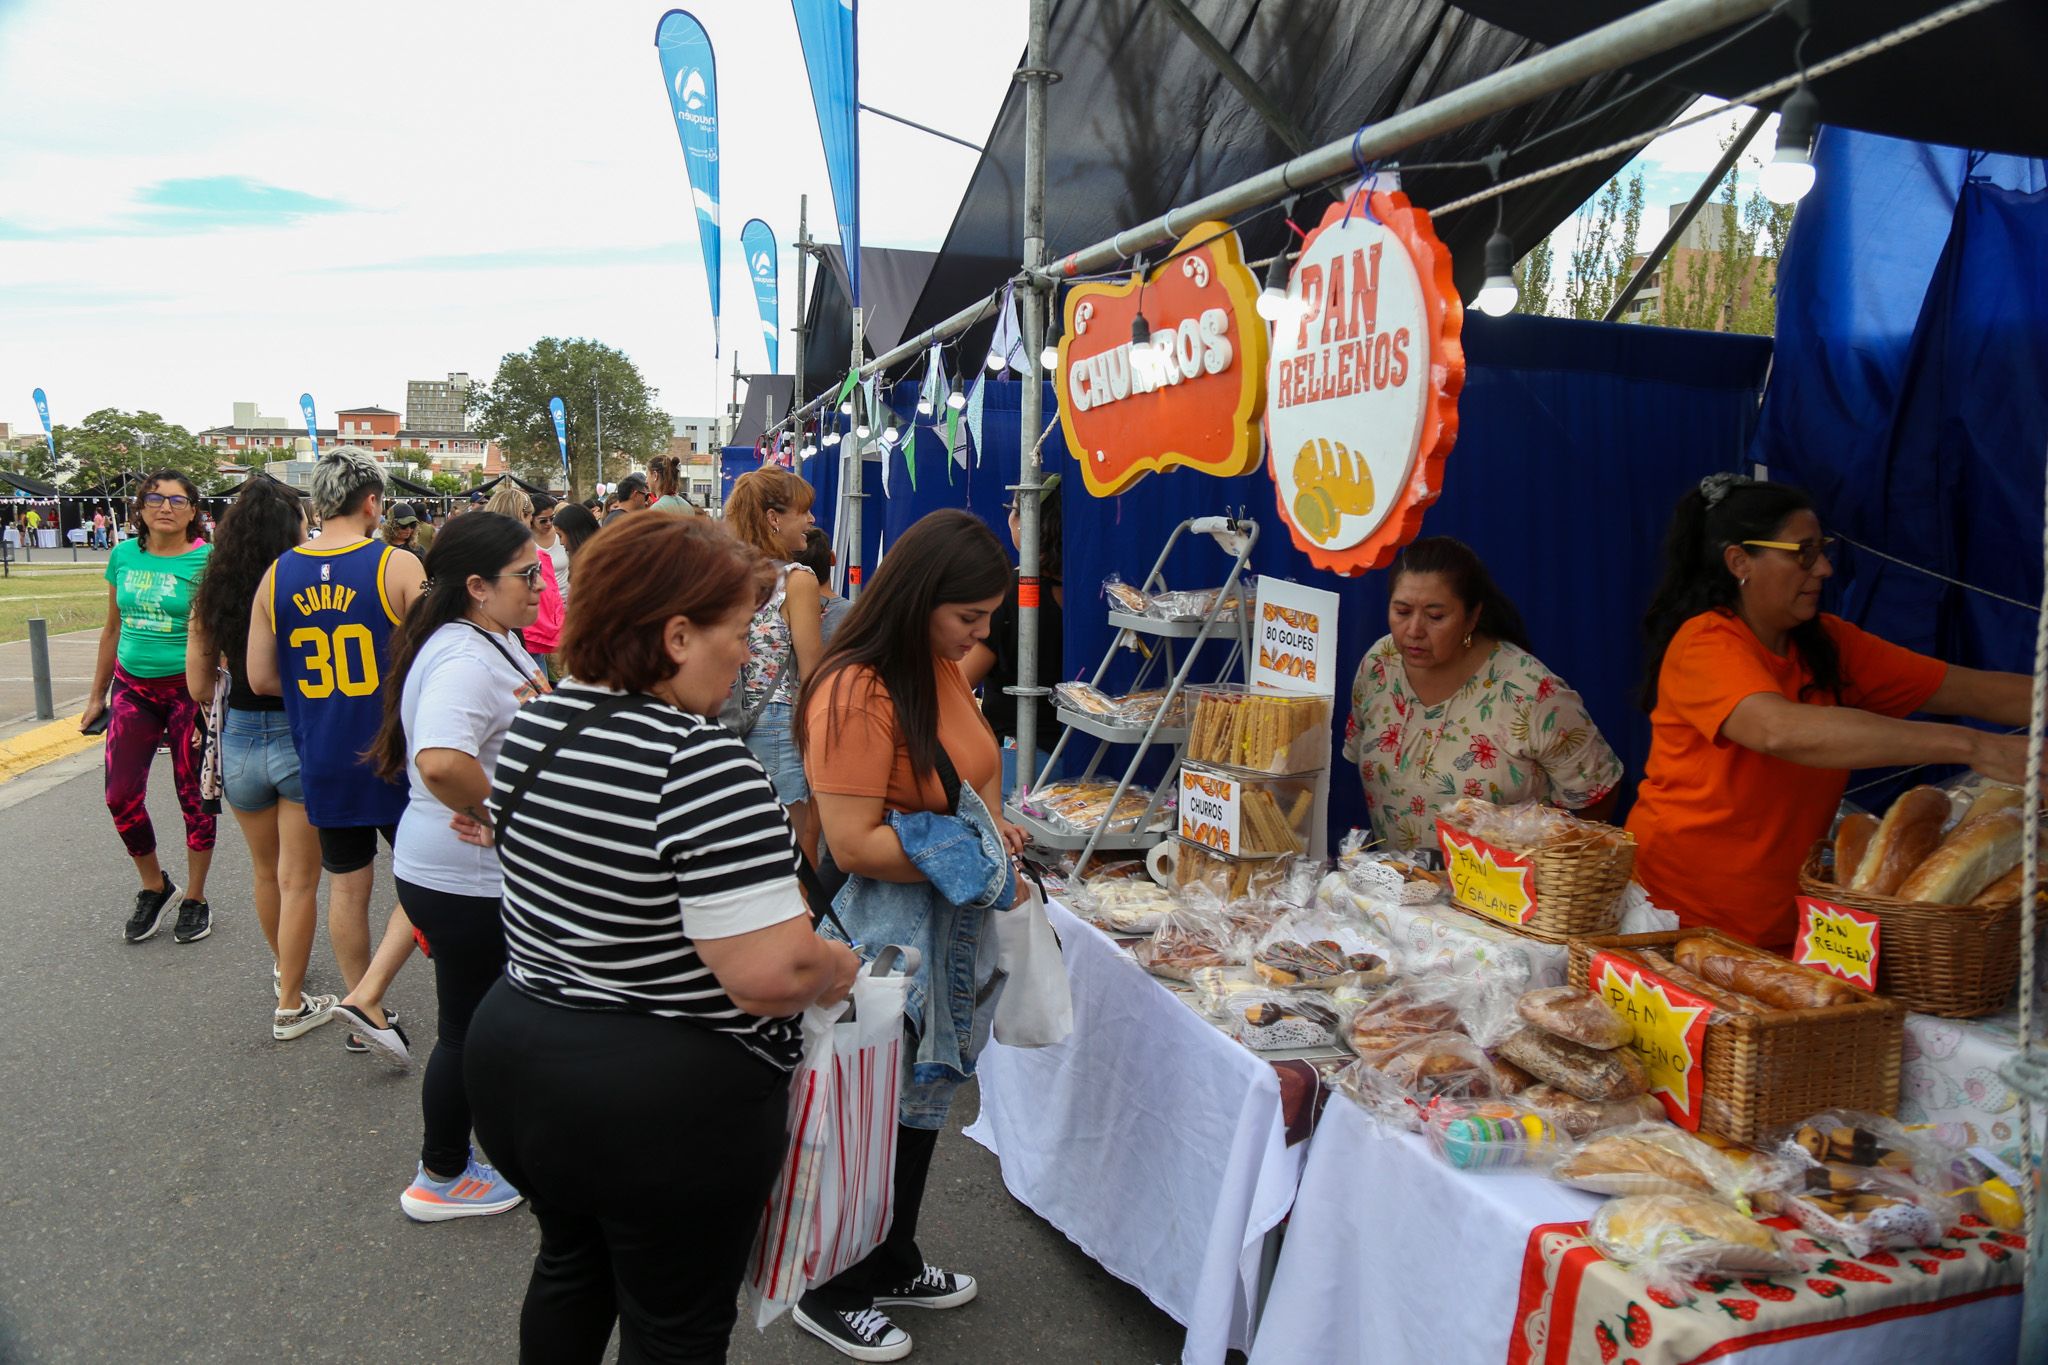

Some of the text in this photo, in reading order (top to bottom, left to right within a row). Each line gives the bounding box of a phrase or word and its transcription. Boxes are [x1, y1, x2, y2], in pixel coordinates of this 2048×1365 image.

[1297, 241, 1383, 350] PAN
[1277, 327, 1410, 409] RELLENOS
[292, 584, 357, 617] CURRY
[1266, 626, 1314, 652] 80 GOLPES
[289, 623, 380, 699] 30
[1190, 797, 1223, 821] CHURROS
[1459, 852, 1487, 877] PAN
[1815, 917, 1848, 938] PAN
[1814, 936, 1871, 963] RELLENO
[1610, 988, 1657, 1027] PAN
